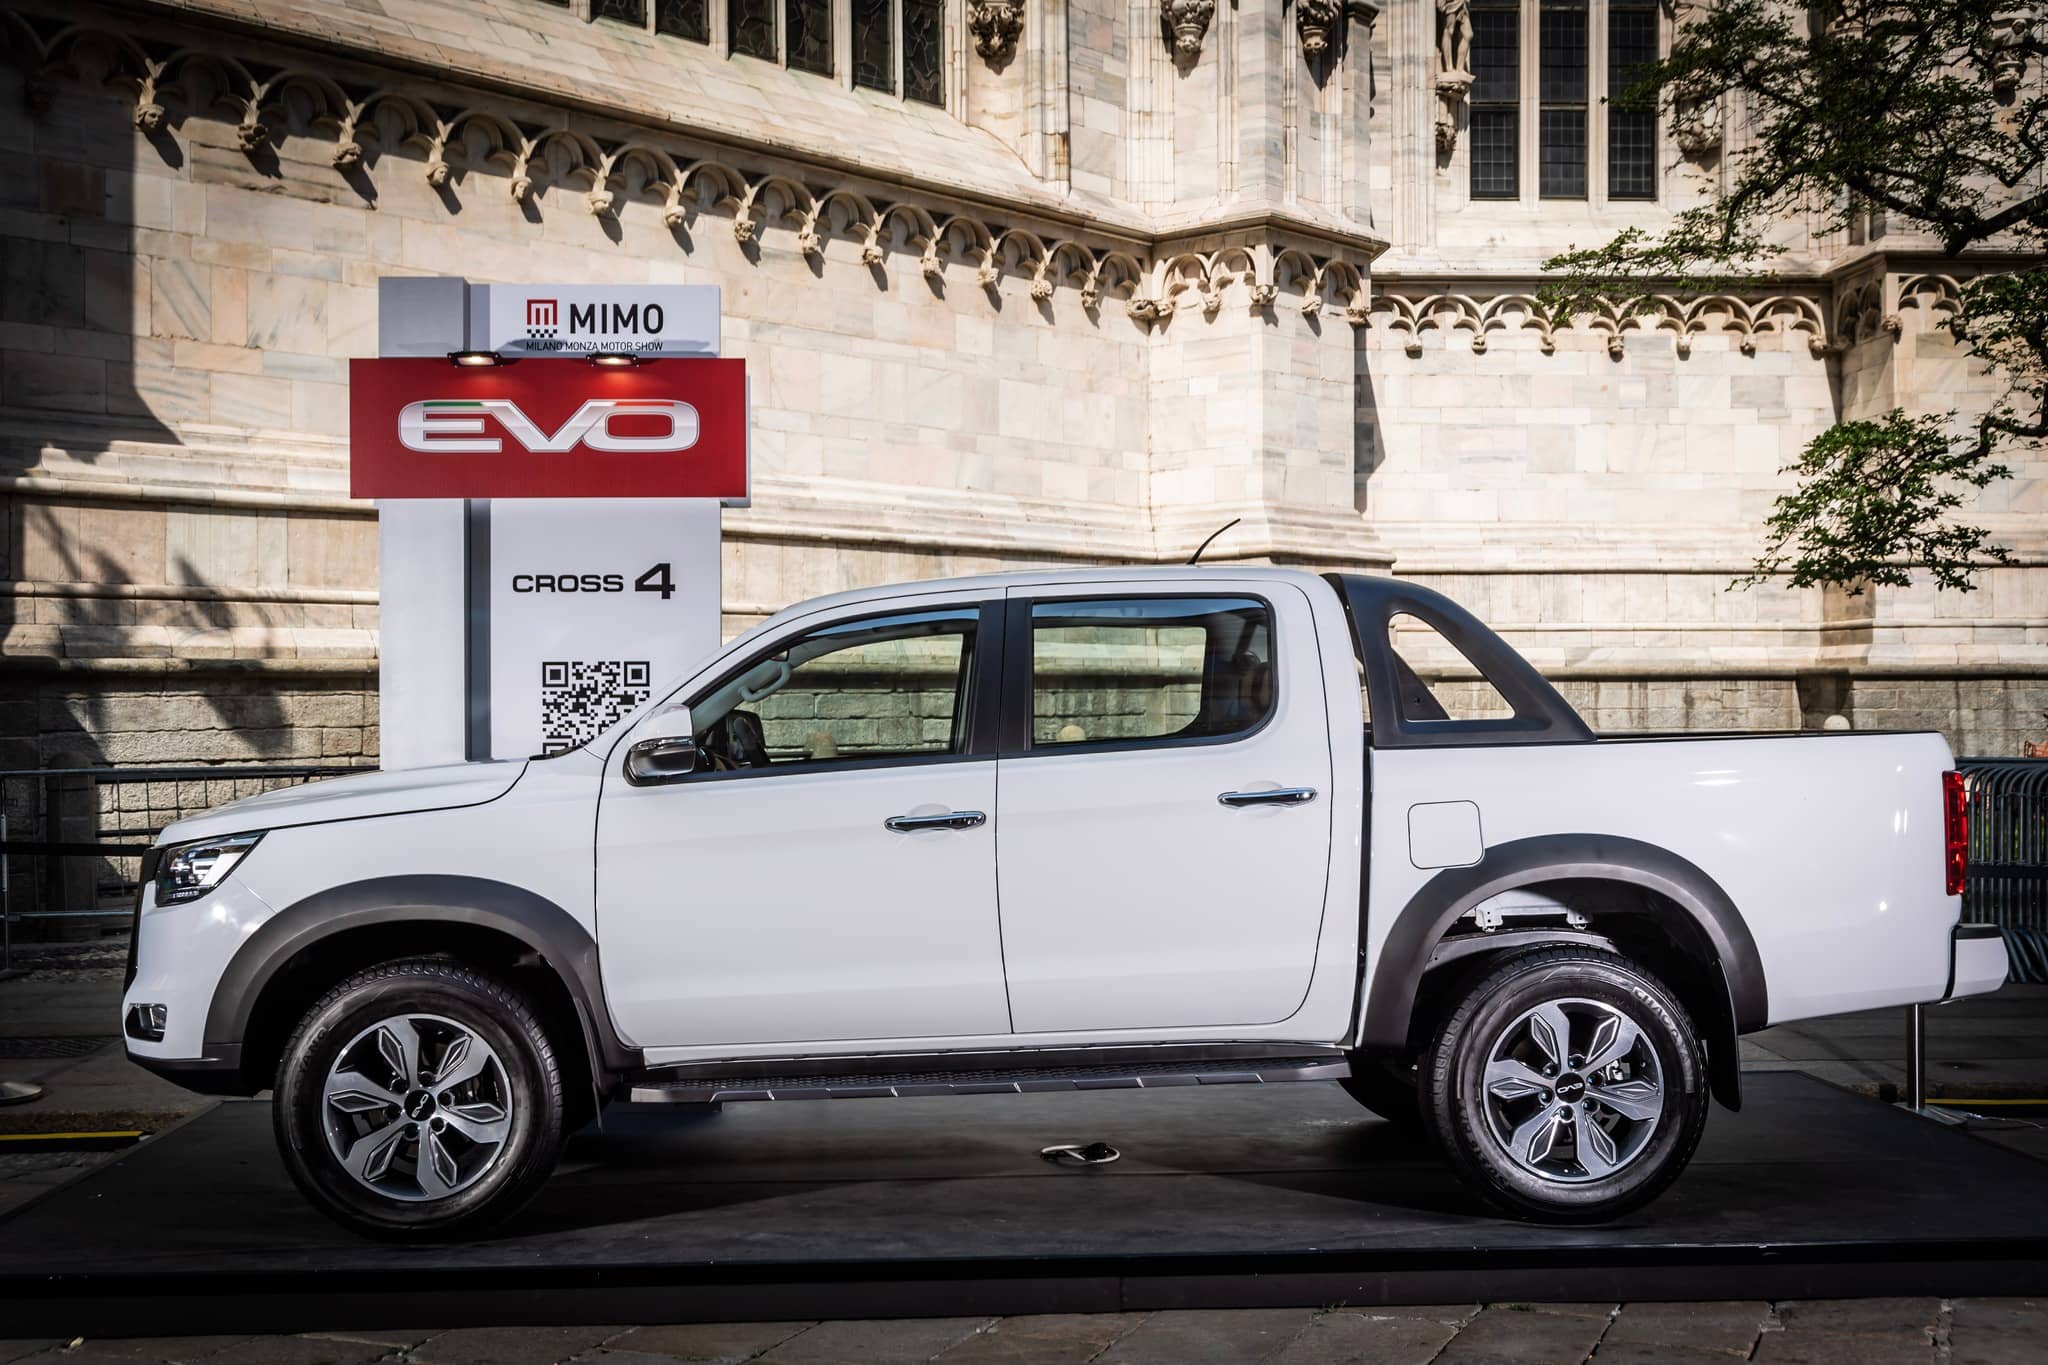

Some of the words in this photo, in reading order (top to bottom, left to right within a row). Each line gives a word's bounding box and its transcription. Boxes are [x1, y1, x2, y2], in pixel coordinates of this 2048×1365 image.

[570, 303, 664, 335] MIMO
[526, 341, 563, 351] MILANO
[564, 341, 598, 351] MONZA
[600, 341, 633, 351] MOTOR
[635, 341, 663, 351] SHOW
[398, 399, 700, 452] EVO
[512, 573, 624, 593] CROSS
[634, 562, 676, 599] 4
[1557, 1082, 1584, 1094] EVO
[411, 1092, 430, 1118] EVO
